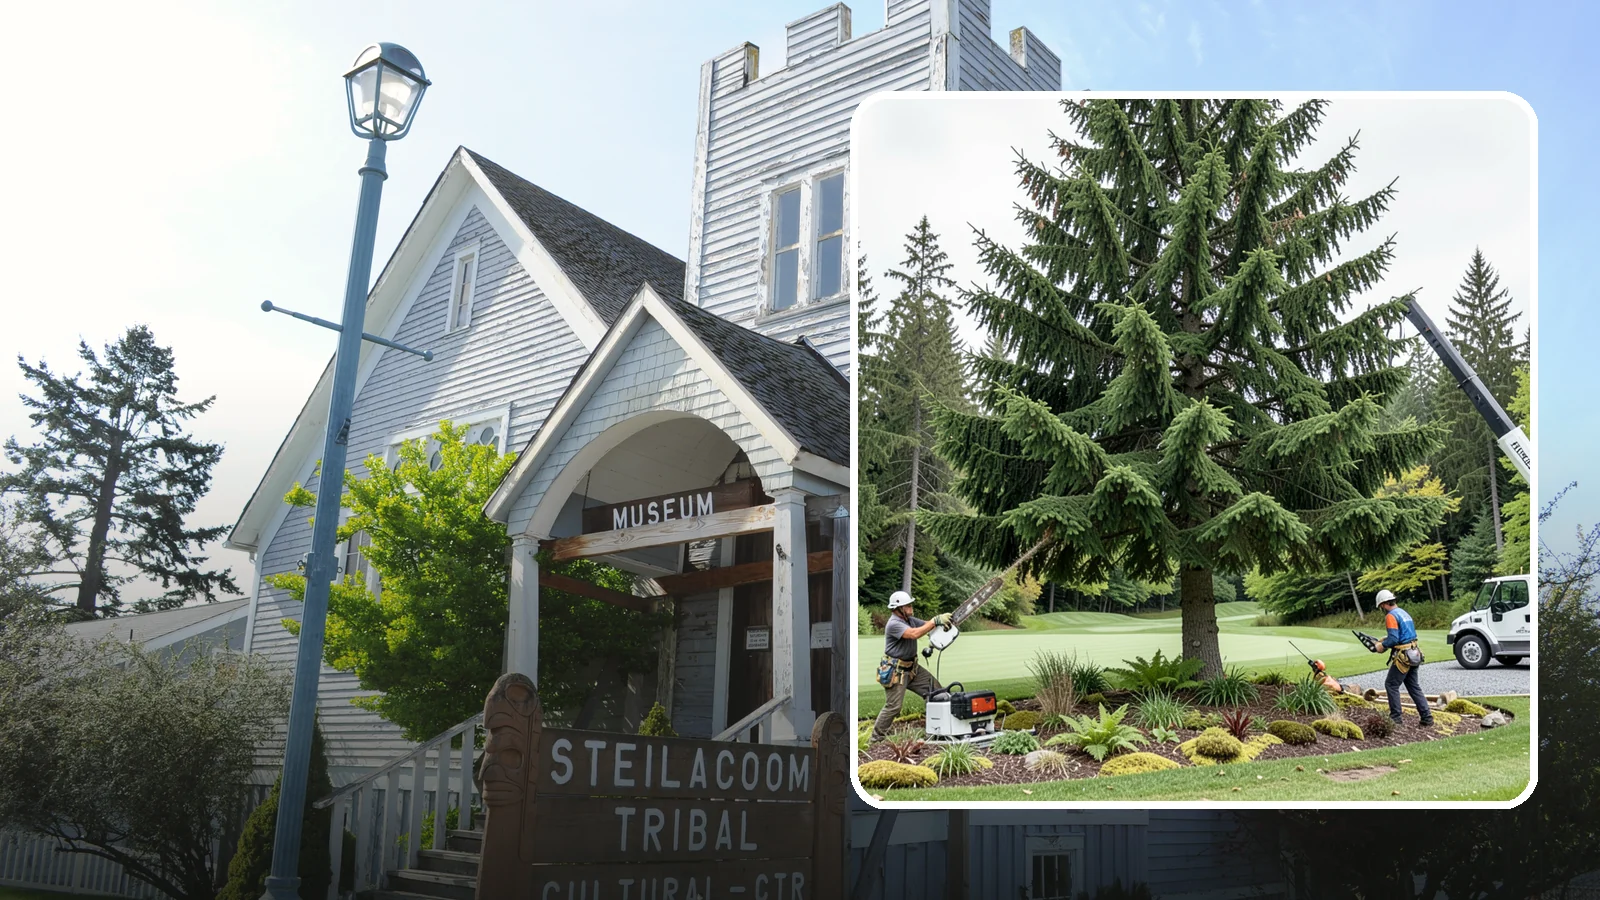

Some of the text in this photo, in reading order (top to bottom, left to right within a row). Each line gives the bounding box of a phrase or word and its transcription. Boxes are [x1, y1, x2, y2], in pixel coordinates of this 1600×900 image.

[613, 491, 714, 530] MUSEUM
[551, 738, 809, 792] STEILACOOM
[615, 807, 758, 851] TRIBAL
